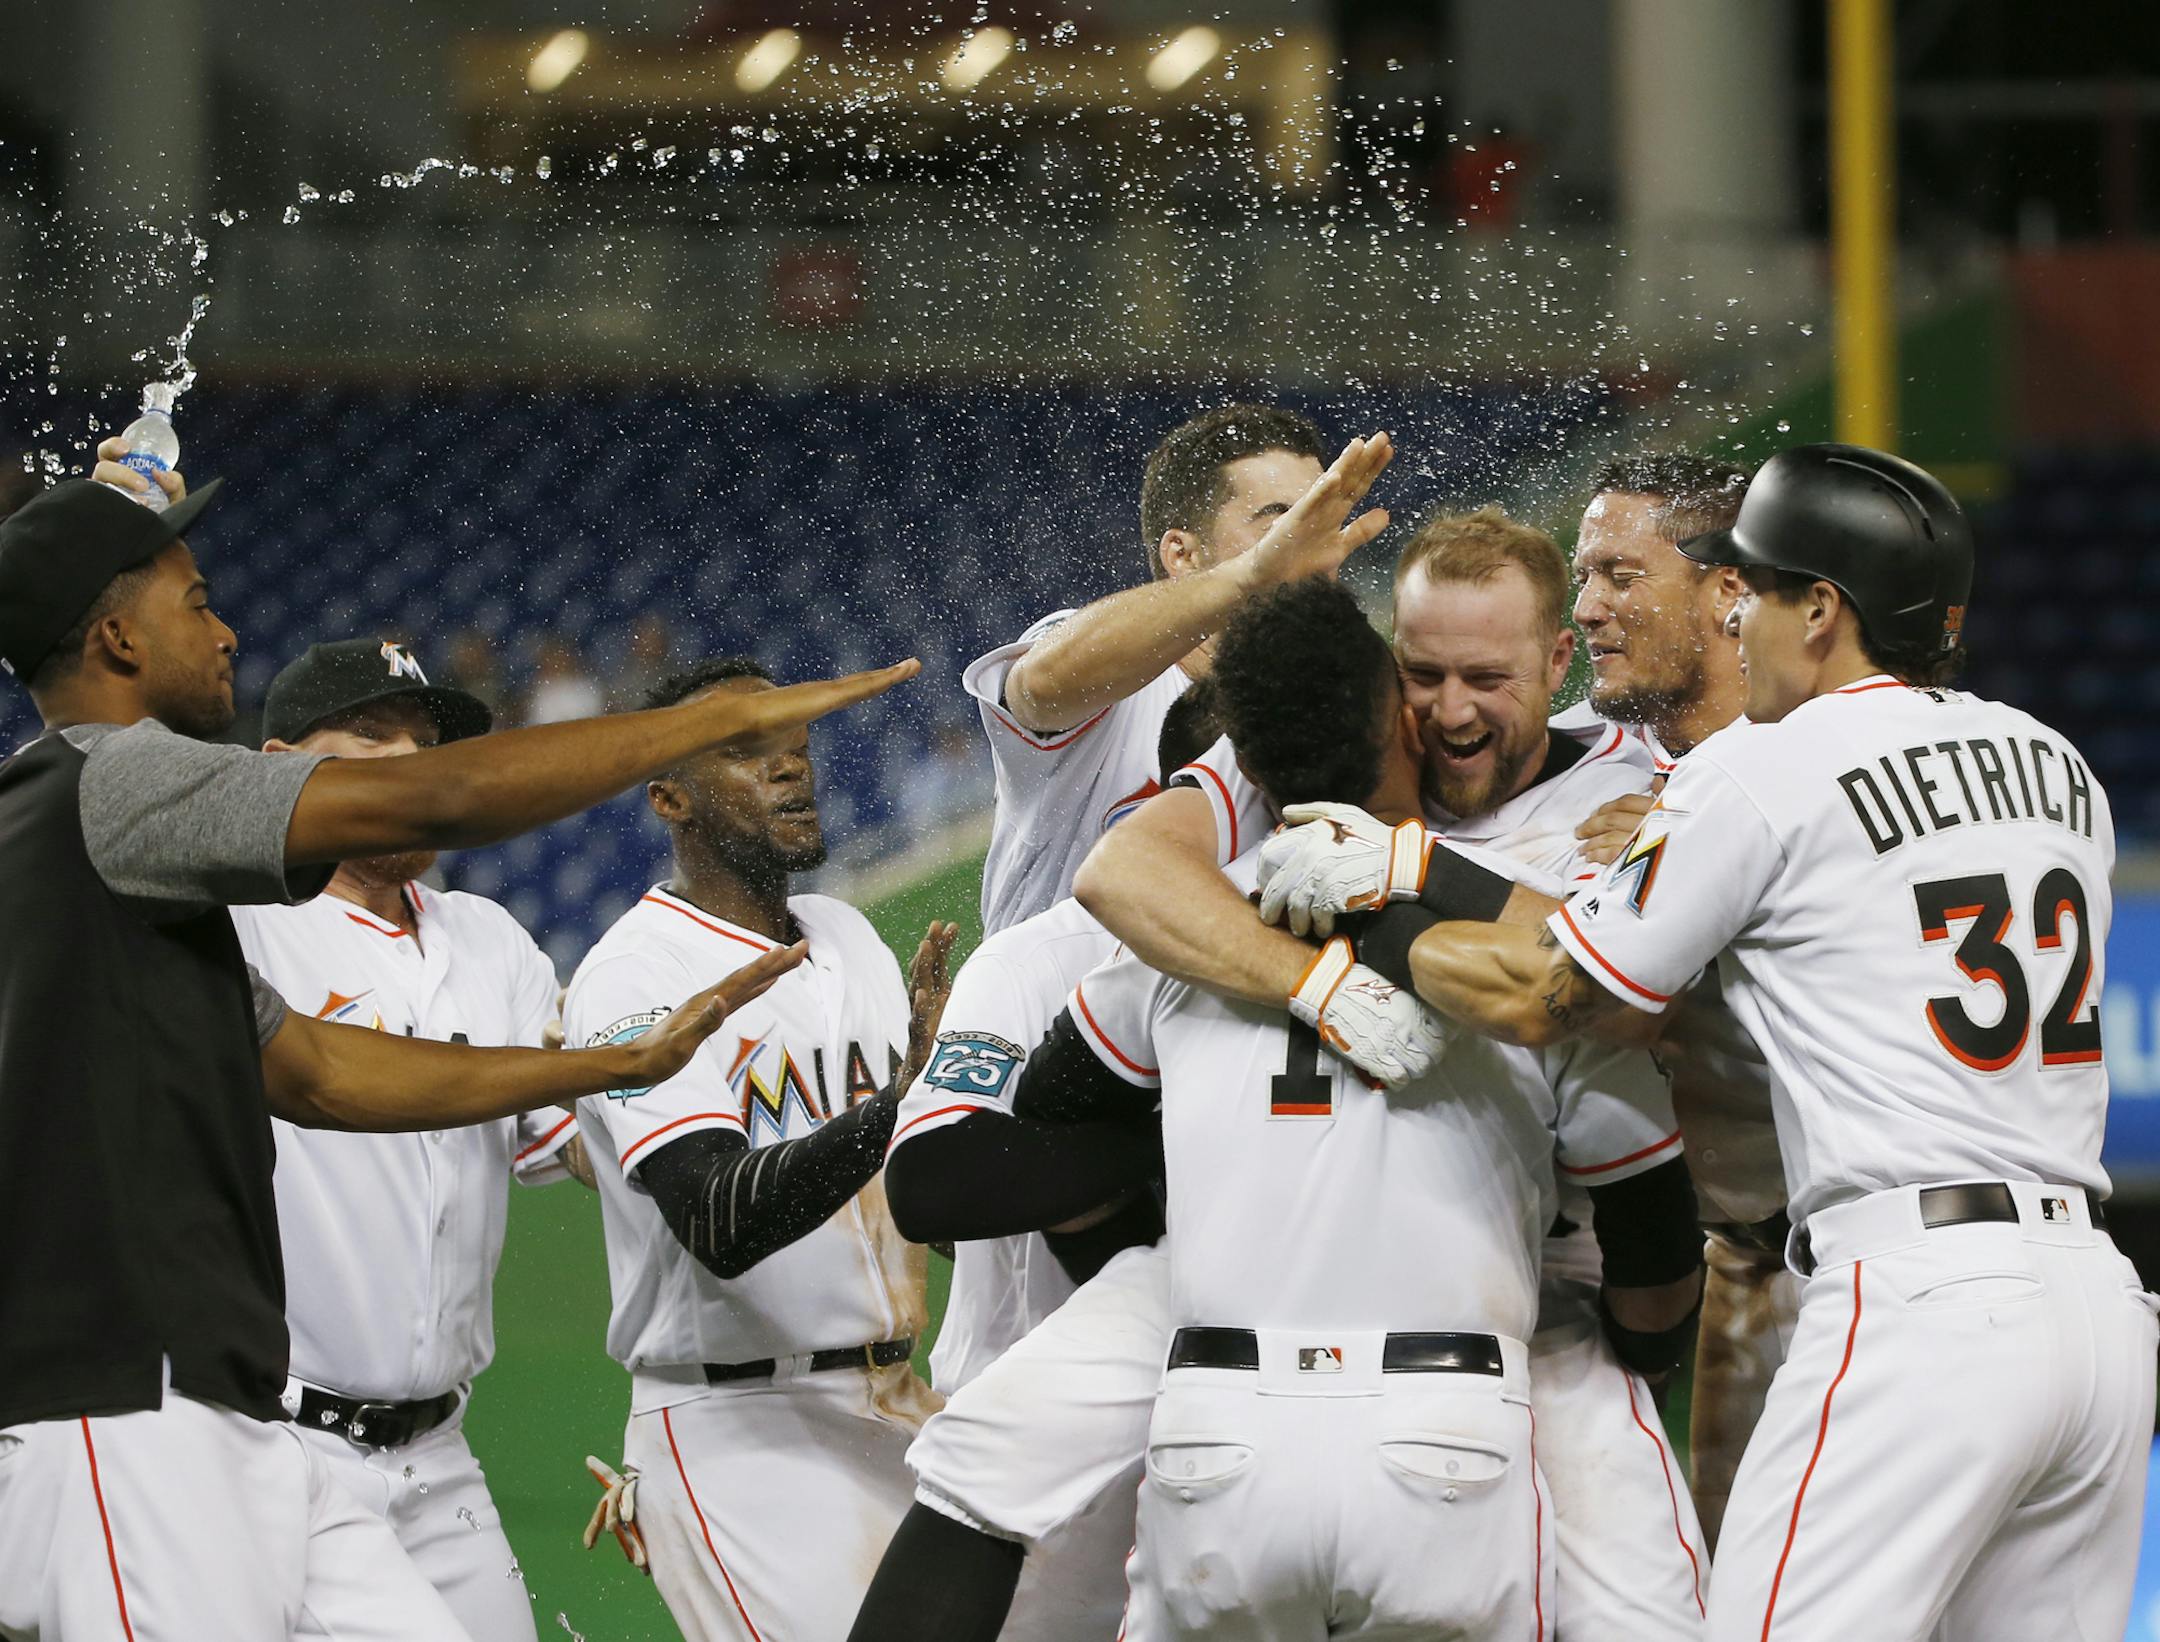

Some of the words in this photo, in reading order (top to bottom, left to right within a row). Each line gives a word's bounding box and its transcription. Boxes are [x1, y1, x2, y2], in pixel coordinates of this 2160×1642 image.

[1837, 735, 2094, 857] DIETRICH
[1914, 868, 2103, 1073] 32
[931, 1044, 1009, 1087] 25
